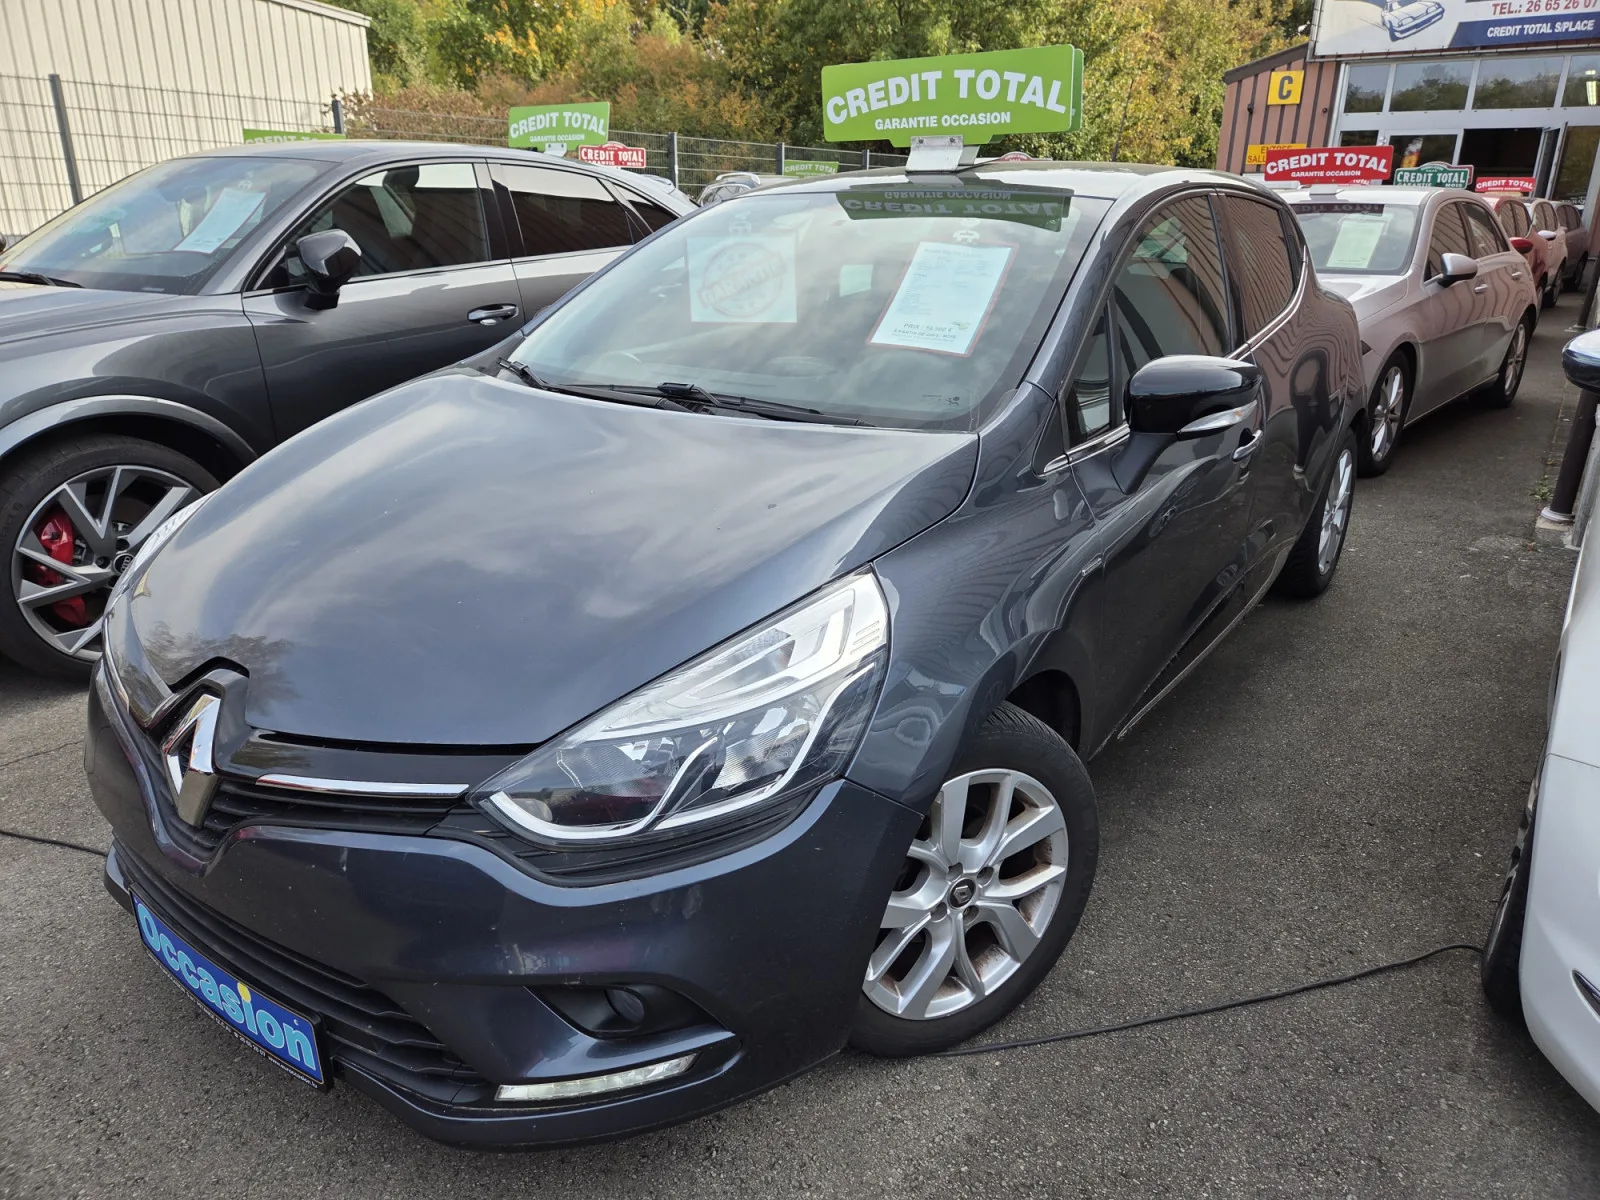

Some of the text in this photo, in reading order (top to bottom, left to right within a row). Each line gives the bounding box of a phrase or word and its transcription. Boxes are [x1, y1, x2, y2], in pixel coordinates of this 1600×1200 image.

[1492, 3, 1522, 15] TEL.:
[1525, 0, 1541, 12] 26
[1545, 0, 1560, 11] 65
[1563, 0, 1580, 9] 26
[1487, 25, 1523, 37] CREDIT
[1523, 23, 1553, 35] TOTAL
[1278, 75, 1294, 100] C
[826, 69, 1067, 124] CREDIT TOTAL
[510, 111, 606, 138] CREDIT TOTAL
[874, 111, 1011, 130] GARANTIE OCCASION
[557, 133, 585, 141] OCCASION
[581, 148, 644, 162] CREDIT TOTAL
[785, 163, 837, 173] CREDIT TOTAL
[1266, 152, 1388, 174] CREDIT TOTAL
[1396, 171, 1466, 183] CREDIT TOTAL
[1476, 180, 1533, 189] CREDIT TOTAL
[137, 903, 316, 1071] Occasion
